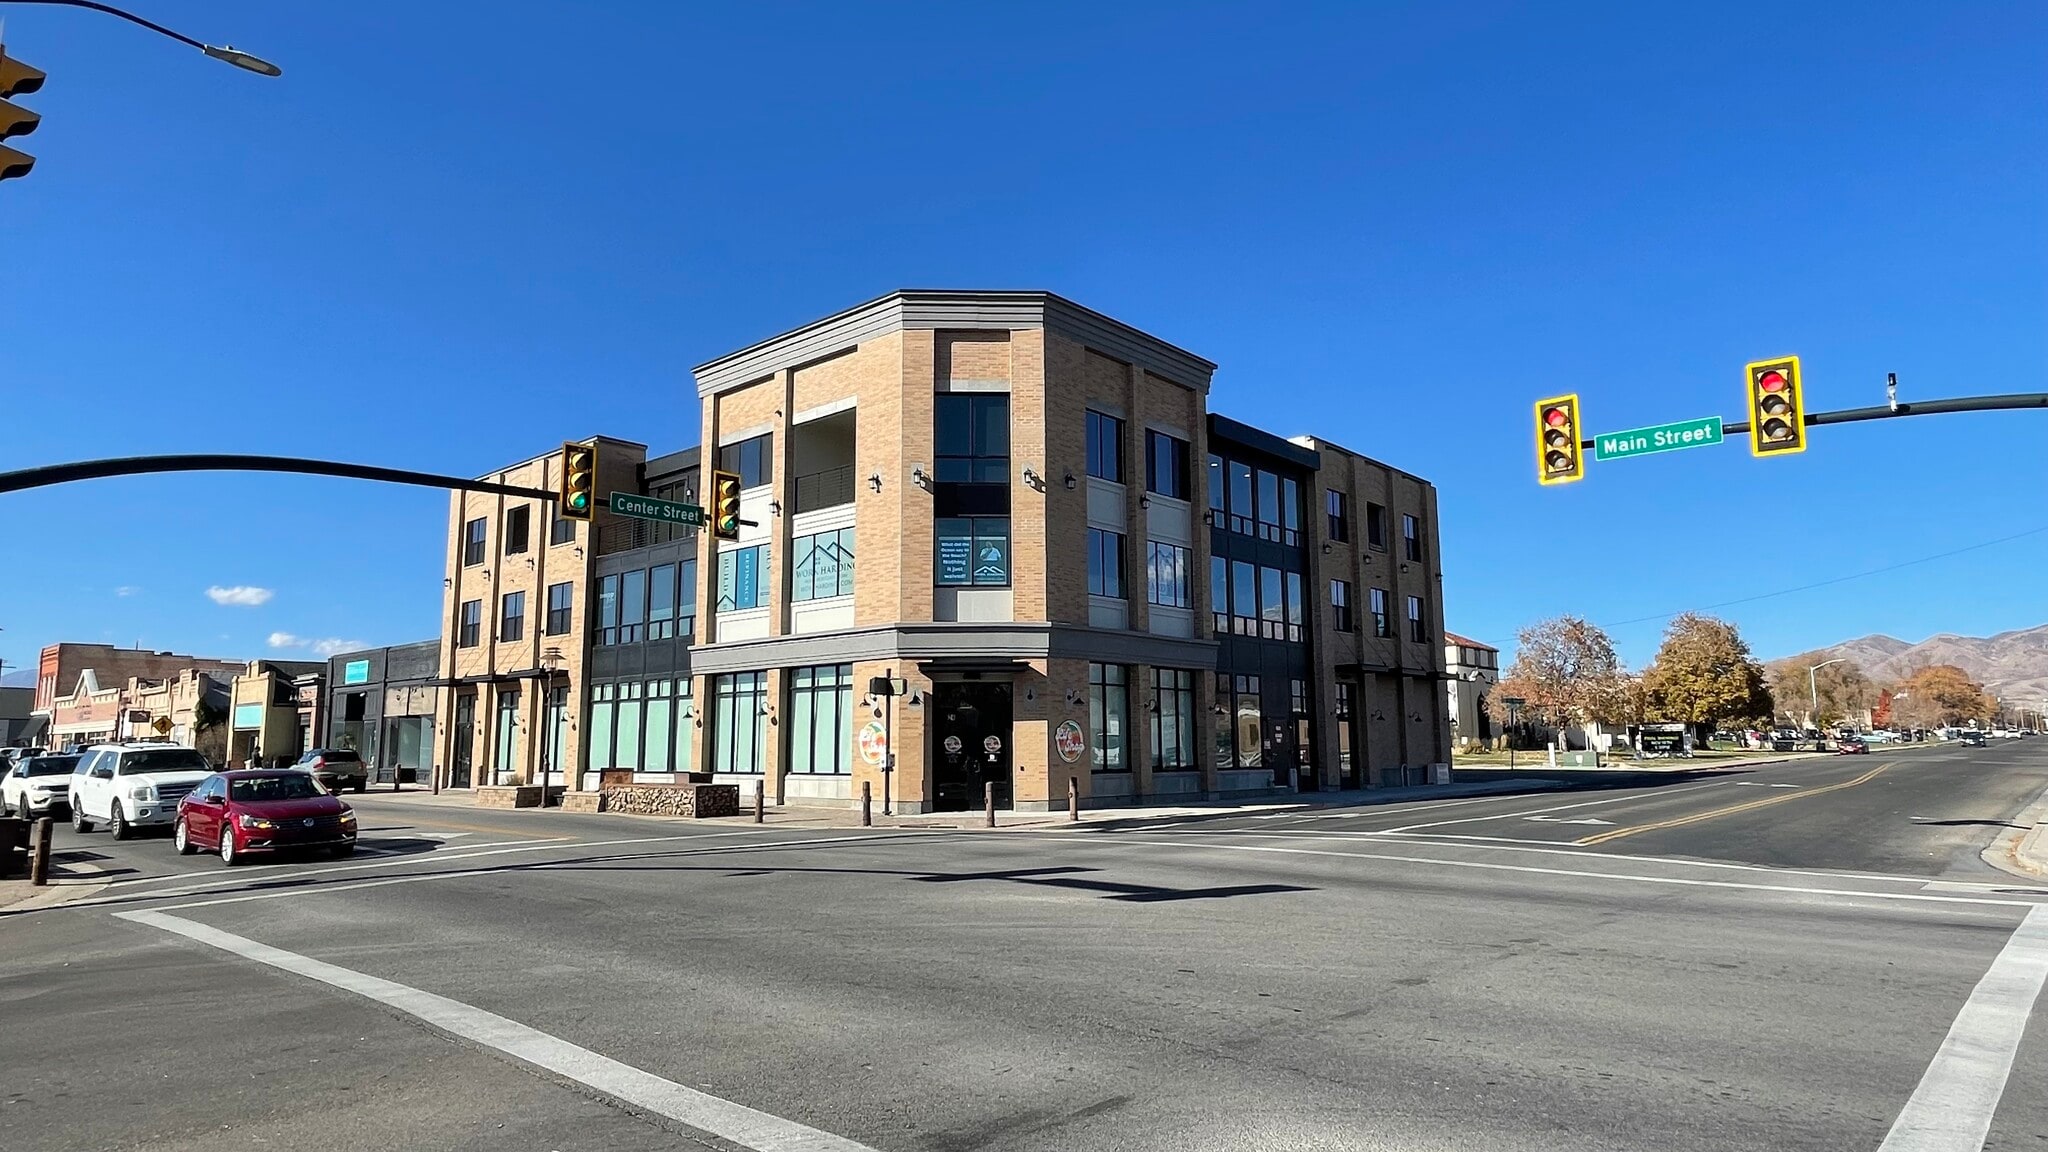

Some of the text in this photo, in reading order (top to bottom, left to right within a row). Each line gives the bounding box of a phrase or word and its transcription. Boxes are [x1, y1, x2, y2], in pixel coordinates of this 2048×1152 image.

[1604, 424, 1712, 454] Main Street
[617, 497, 699, 521] Center Street
